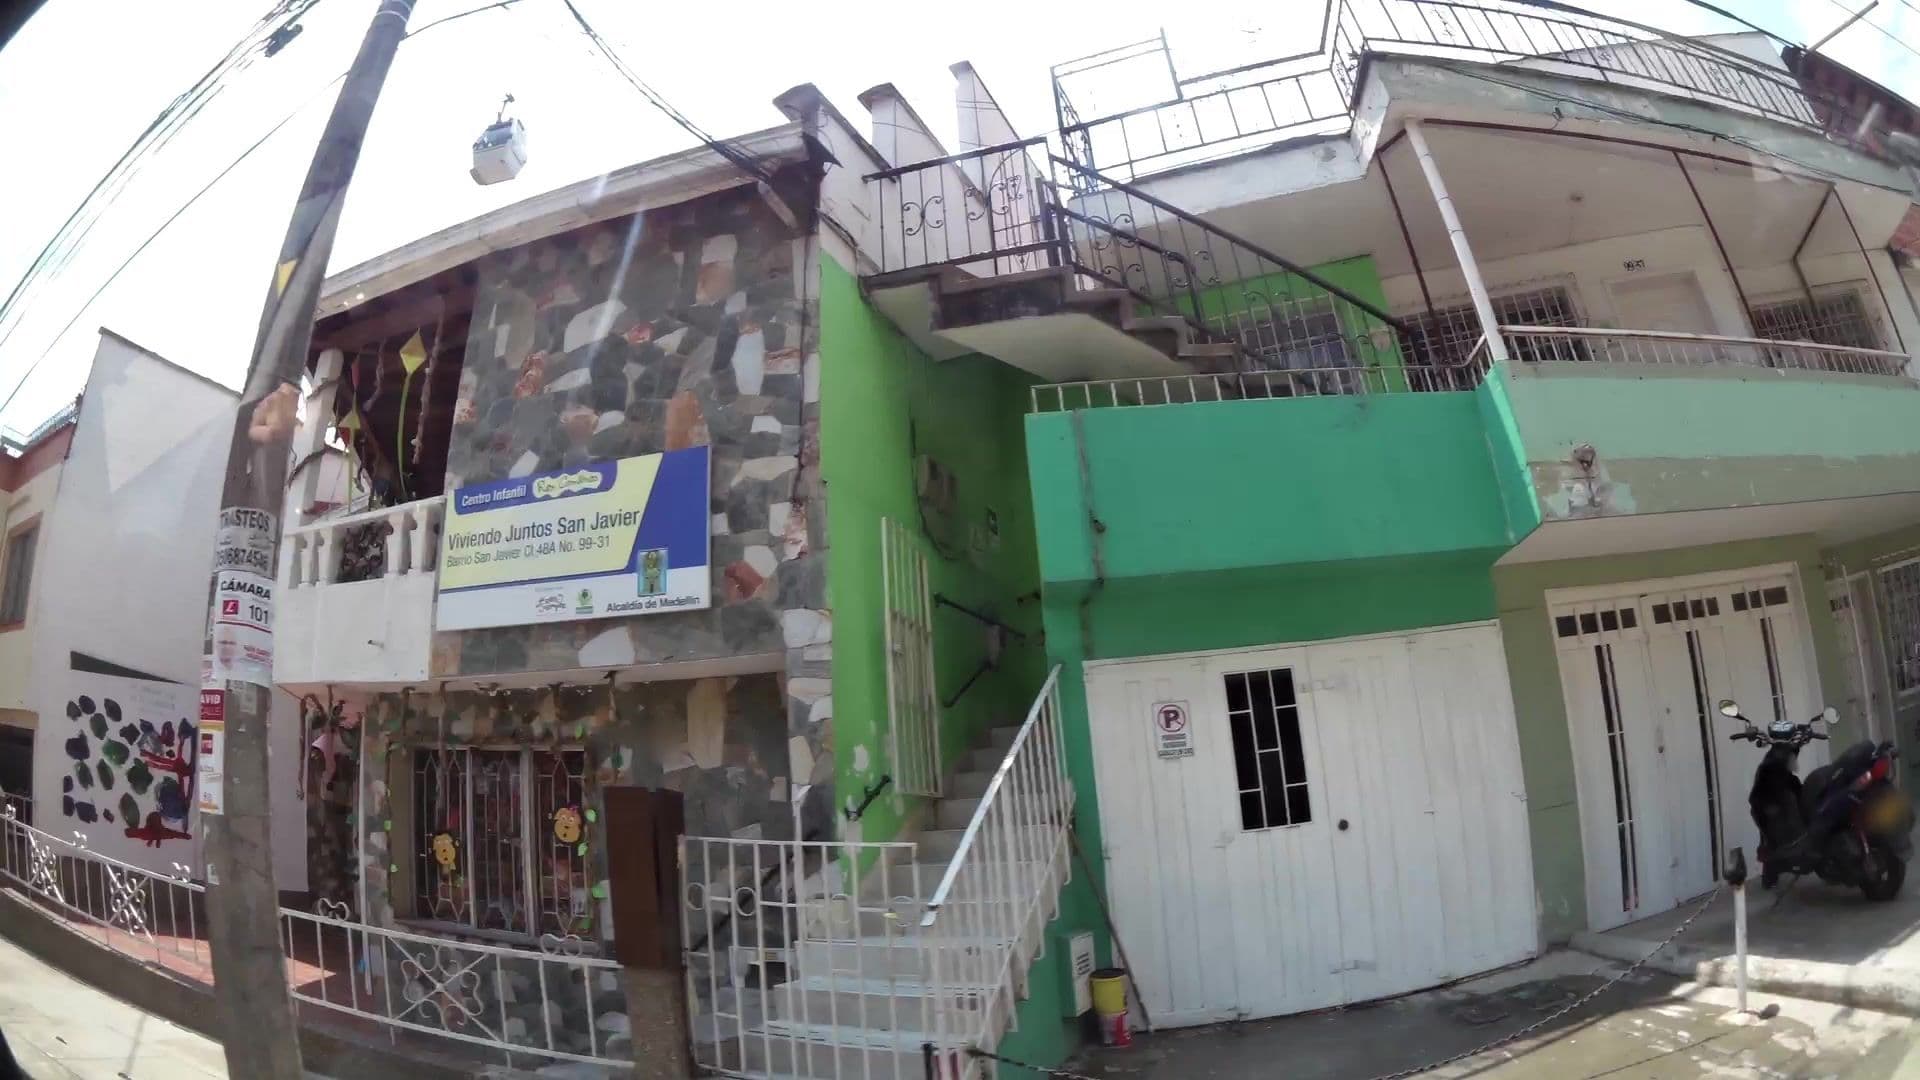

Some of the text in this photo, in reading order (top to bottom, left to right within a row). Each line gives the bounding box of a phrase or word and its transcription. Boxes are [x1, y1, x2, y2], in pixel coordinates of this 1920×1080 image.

[462, 484, 527, 506] Centro Infantil
[219, 509, 271, 532] TRASTEOS
[448, 508, 640, 550] Viviendo Juntos San Javier
[474, 551, 491, 564] San
[559, 539, 576, 552] No.
[579, 535, 610, 550] 99-31
[220, 577, 271, 600] CÁMARA
[249, 605, 269, 625] 101
[606, 600, 643, 612] Alcaldía
[645, 599, 657, 609] de
